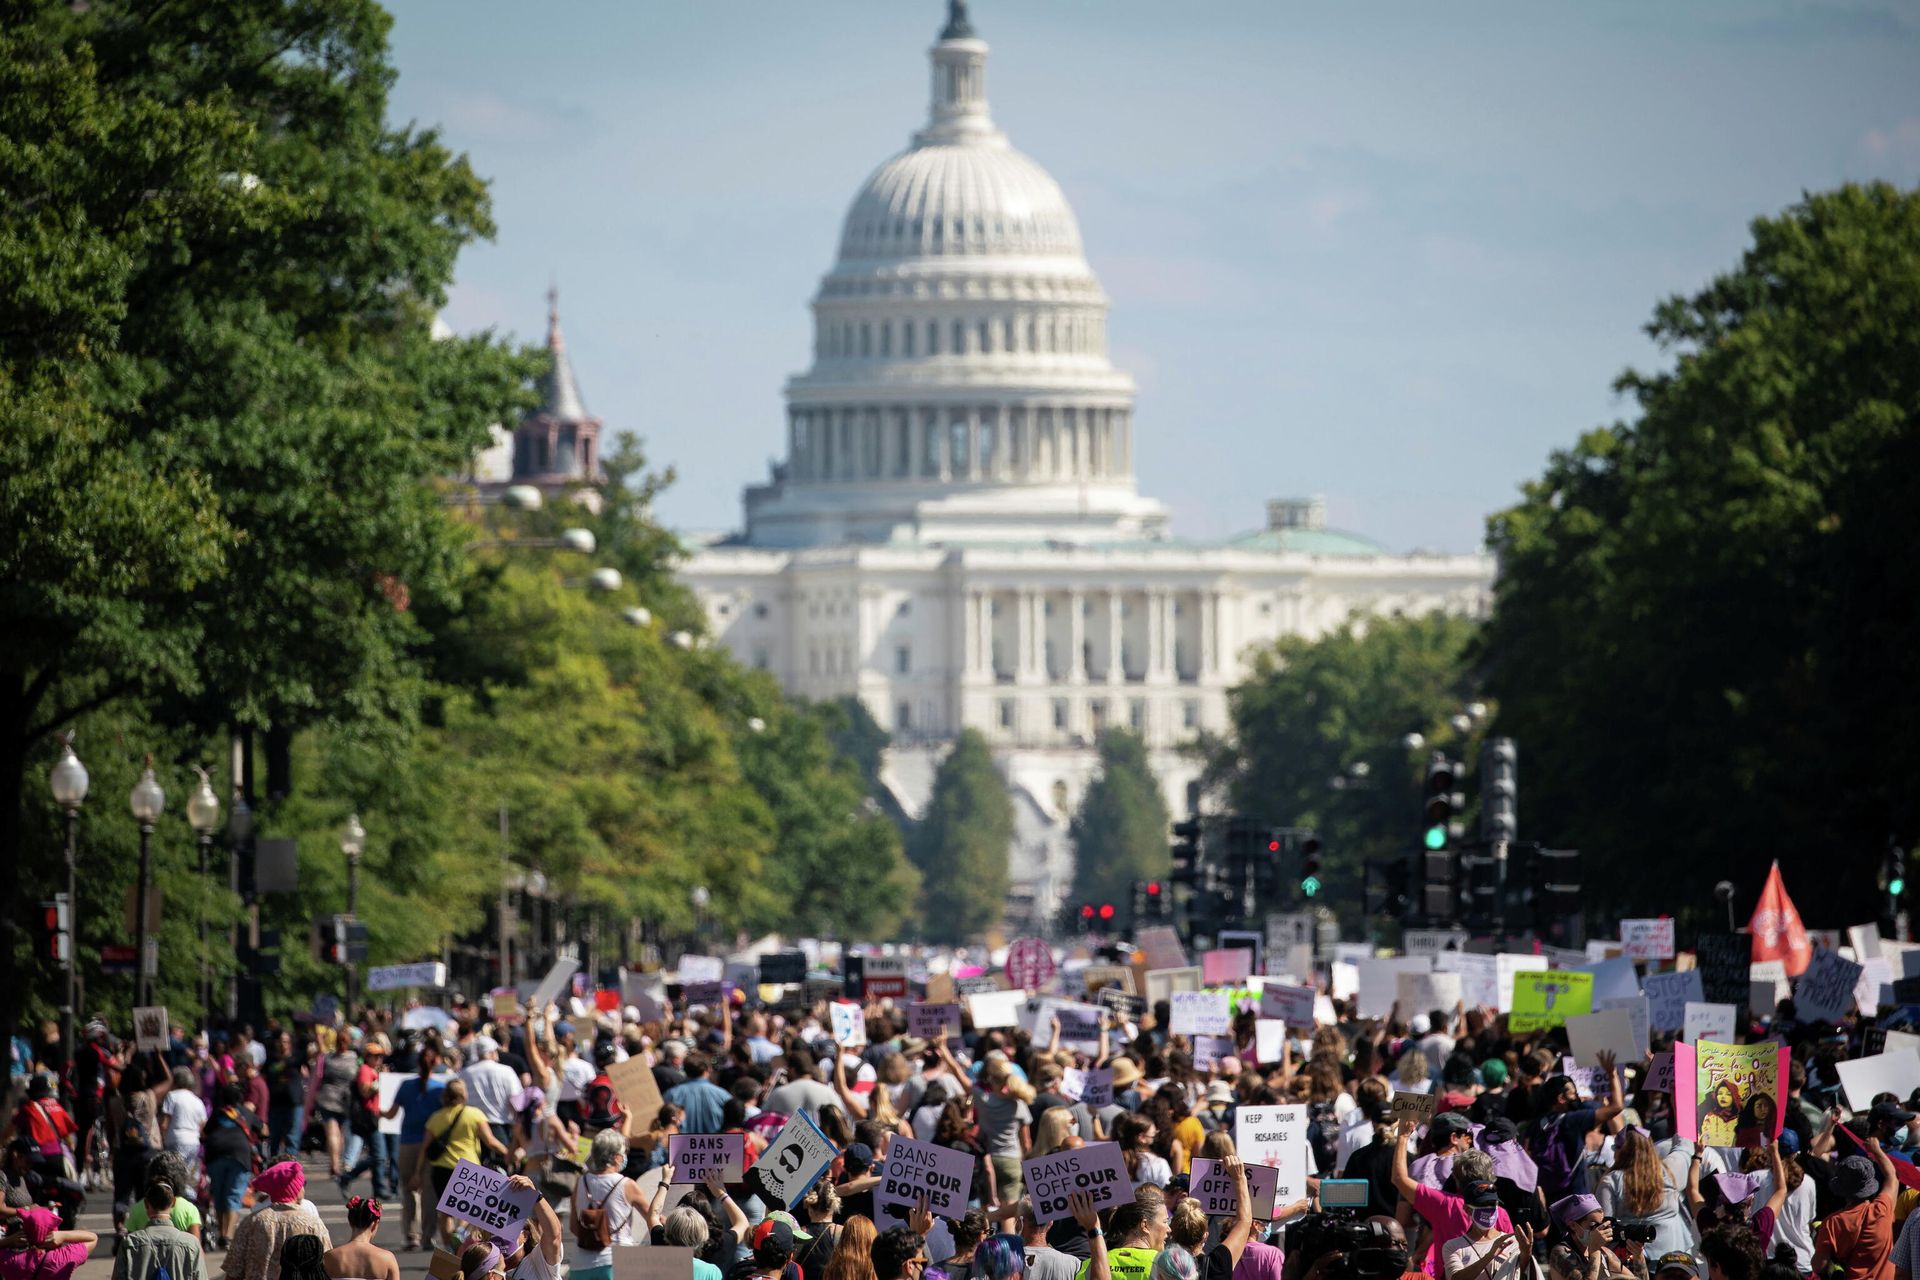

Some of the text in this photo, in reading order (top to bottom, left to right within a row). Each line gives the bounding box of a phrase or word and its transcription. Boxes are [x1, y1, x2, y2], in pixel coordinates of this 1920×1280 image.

[1645, 973, 1693, 999] STOP
[1702, 1056, 1725, 1068] Come
[1658, 1066, 1675, 1076] OF
[1245, 1112, 1295, 1123] KEEP YOUR
[690, 1138, 724, 1149] BANS
[1255, 1132, 1288, 1142] ROSARIES
[682, 1153, 731, 1164] OFF MY
[893, 1144, 937, 1167] BANS
[890, 1162, 961, 1193] OFF OUR
[1030, 1157, 1080, 1182] BANS
[1213, 1164, 1253, 1180] BAS
[458, 1167, 501, 1193] BANS
[1036, 1167, 1119, 1197] OFF OUR
[1203, 1180, 1231, 1194] OFF
[453, 1182, 520, 1220] OFF OUR
[885, 1179, 951, 1208] BODIES
[445, 1194, 507, 1229] BODIES
[1209, 1198, 1237, 1212] BOD
[1110, 1264, 1145, 1273] LUNTEER
